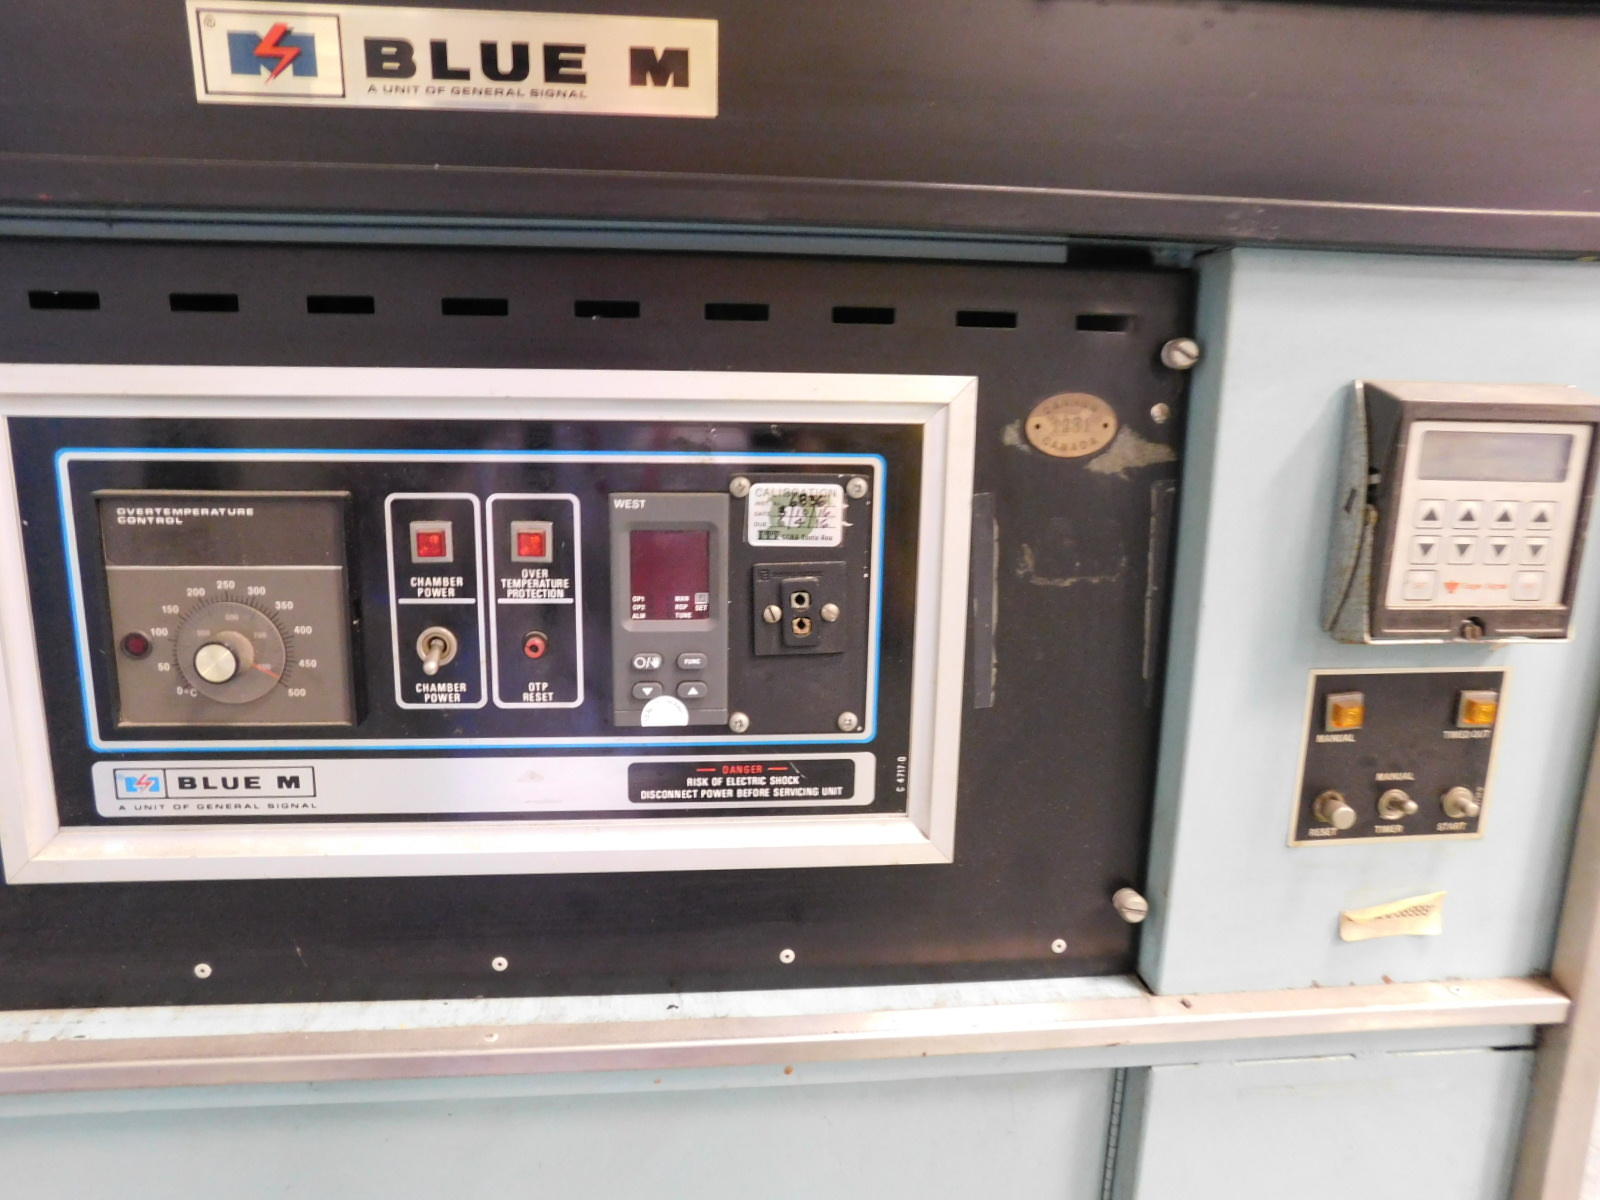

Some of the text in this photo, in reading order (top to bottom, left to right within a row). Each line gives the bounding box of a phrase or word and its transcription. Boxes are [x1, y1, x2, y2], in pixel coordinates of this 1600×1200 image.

[363, 36, 690, 88] BLUE M
[367, 84, 588, 100] A UNIT OF GENERAL SIGNAL
[613, 499, 647, 510] WEST
[116, 507, 254, 517] OVERTEMPERATURE
[117, 516, 184, 526] CONTROL
[521, 568, 549, 579] OVER
[216, 580, 236, 590] 250
[410, 576, 464, 588] CHAMBER
[500, 578, 570, 589] TEMPERATURE
[186, 587, 206, 597] 200
[247, 586, 266, 596] 300
[417, 587, 456, 598] POWER
[506, 588, 565, 599] PROTECTION
[161, 604, 180, 614] 150
[275, 600, 294, 611] 350
[150, 627, 169, 637] 100
[294, 625, 312, 635] 400
[157, 662, 171, 672] 50
[298, 659, 317, 669] 450
[415, 682, 467, 693] CHAMBER
[528, 682, 549, 692] OTP
[288, 688, 306, 698] 500
[423, 693, 461, 704] POWER
[522, 692, 554, 702] RESET
[721, 764, 764, 775] DANGER
[177, 775, 301, 790] BLUE M
[686, 775, 801, 787] RISK OF ELECTRIC SHOCK
[640, 786, 843, 800] DISCONNECT POWER BEFORE SERVICING UNIT
[172, 803, 190, 811] OF
[196, 803, 260, 811] GENERAL
[267, 802, 317, 810] SIGNAL
